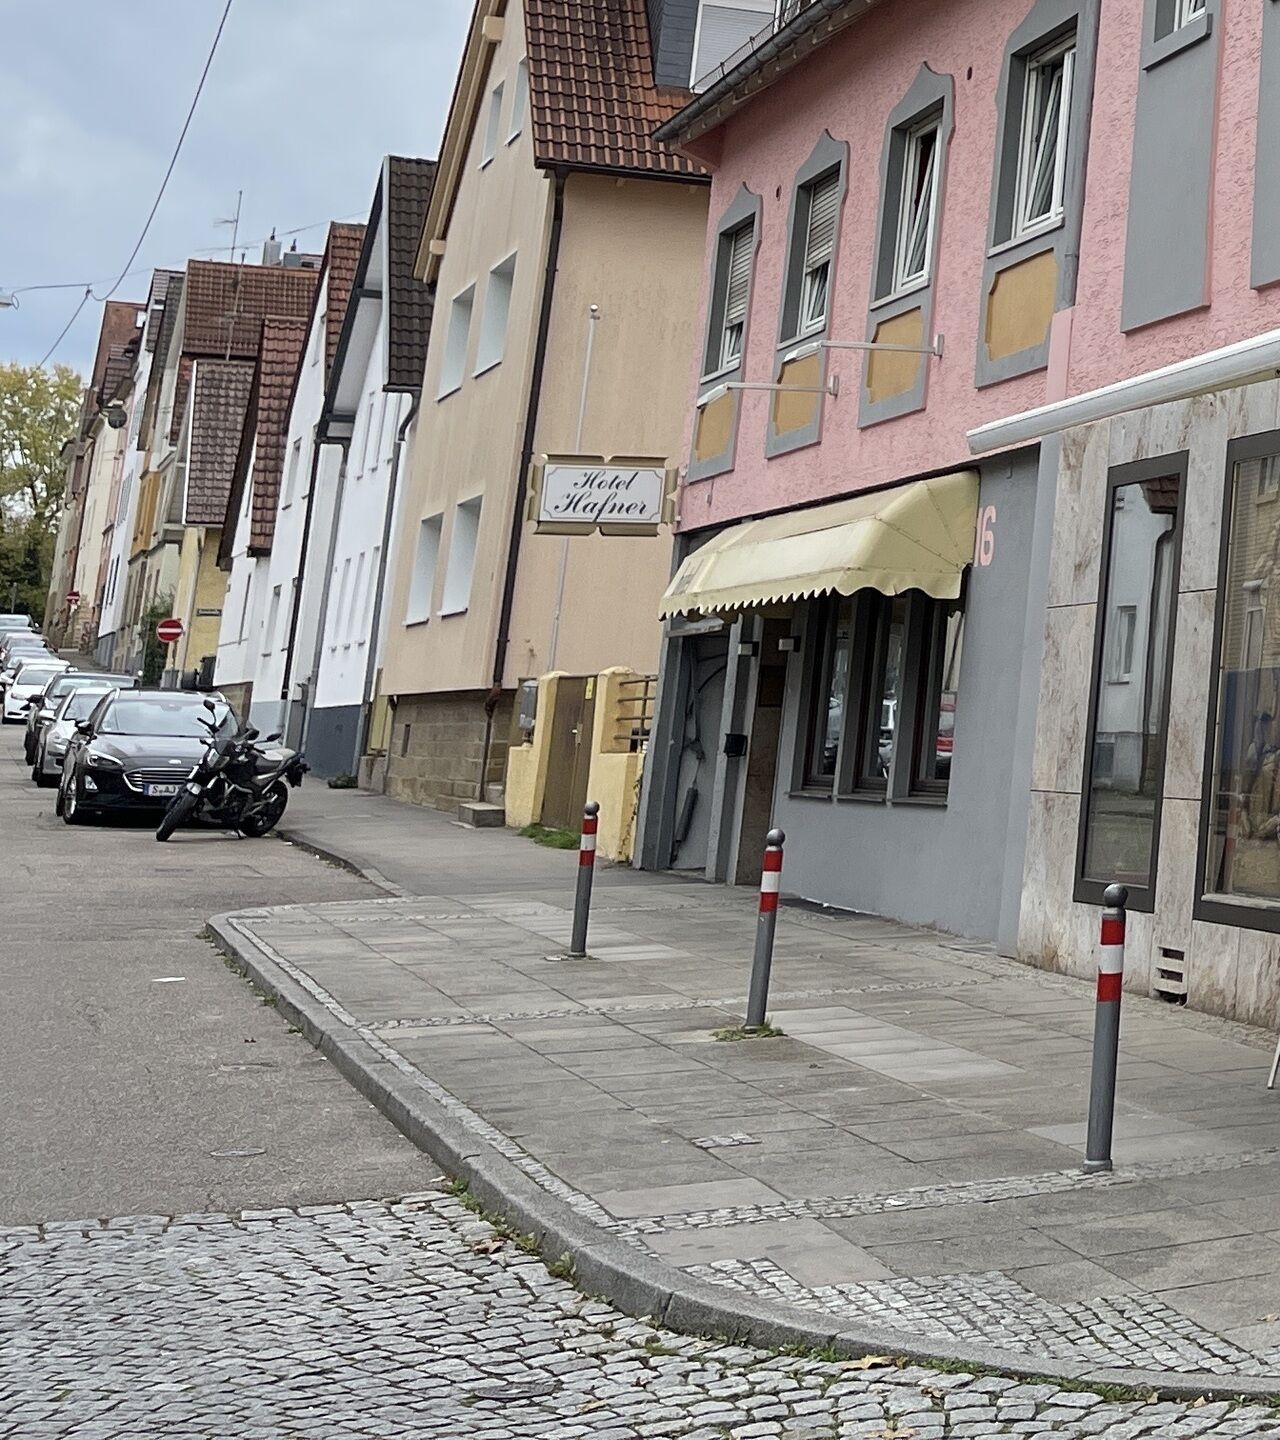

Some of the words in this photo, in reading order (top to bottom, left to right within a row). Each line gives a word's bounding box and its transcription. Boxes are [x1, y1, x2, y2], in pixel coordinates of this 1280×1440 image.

[573, 471, 640, 490] Hotel
[553, 491, 647, 523] Hafner
[974, 505, 996, 567] 16
